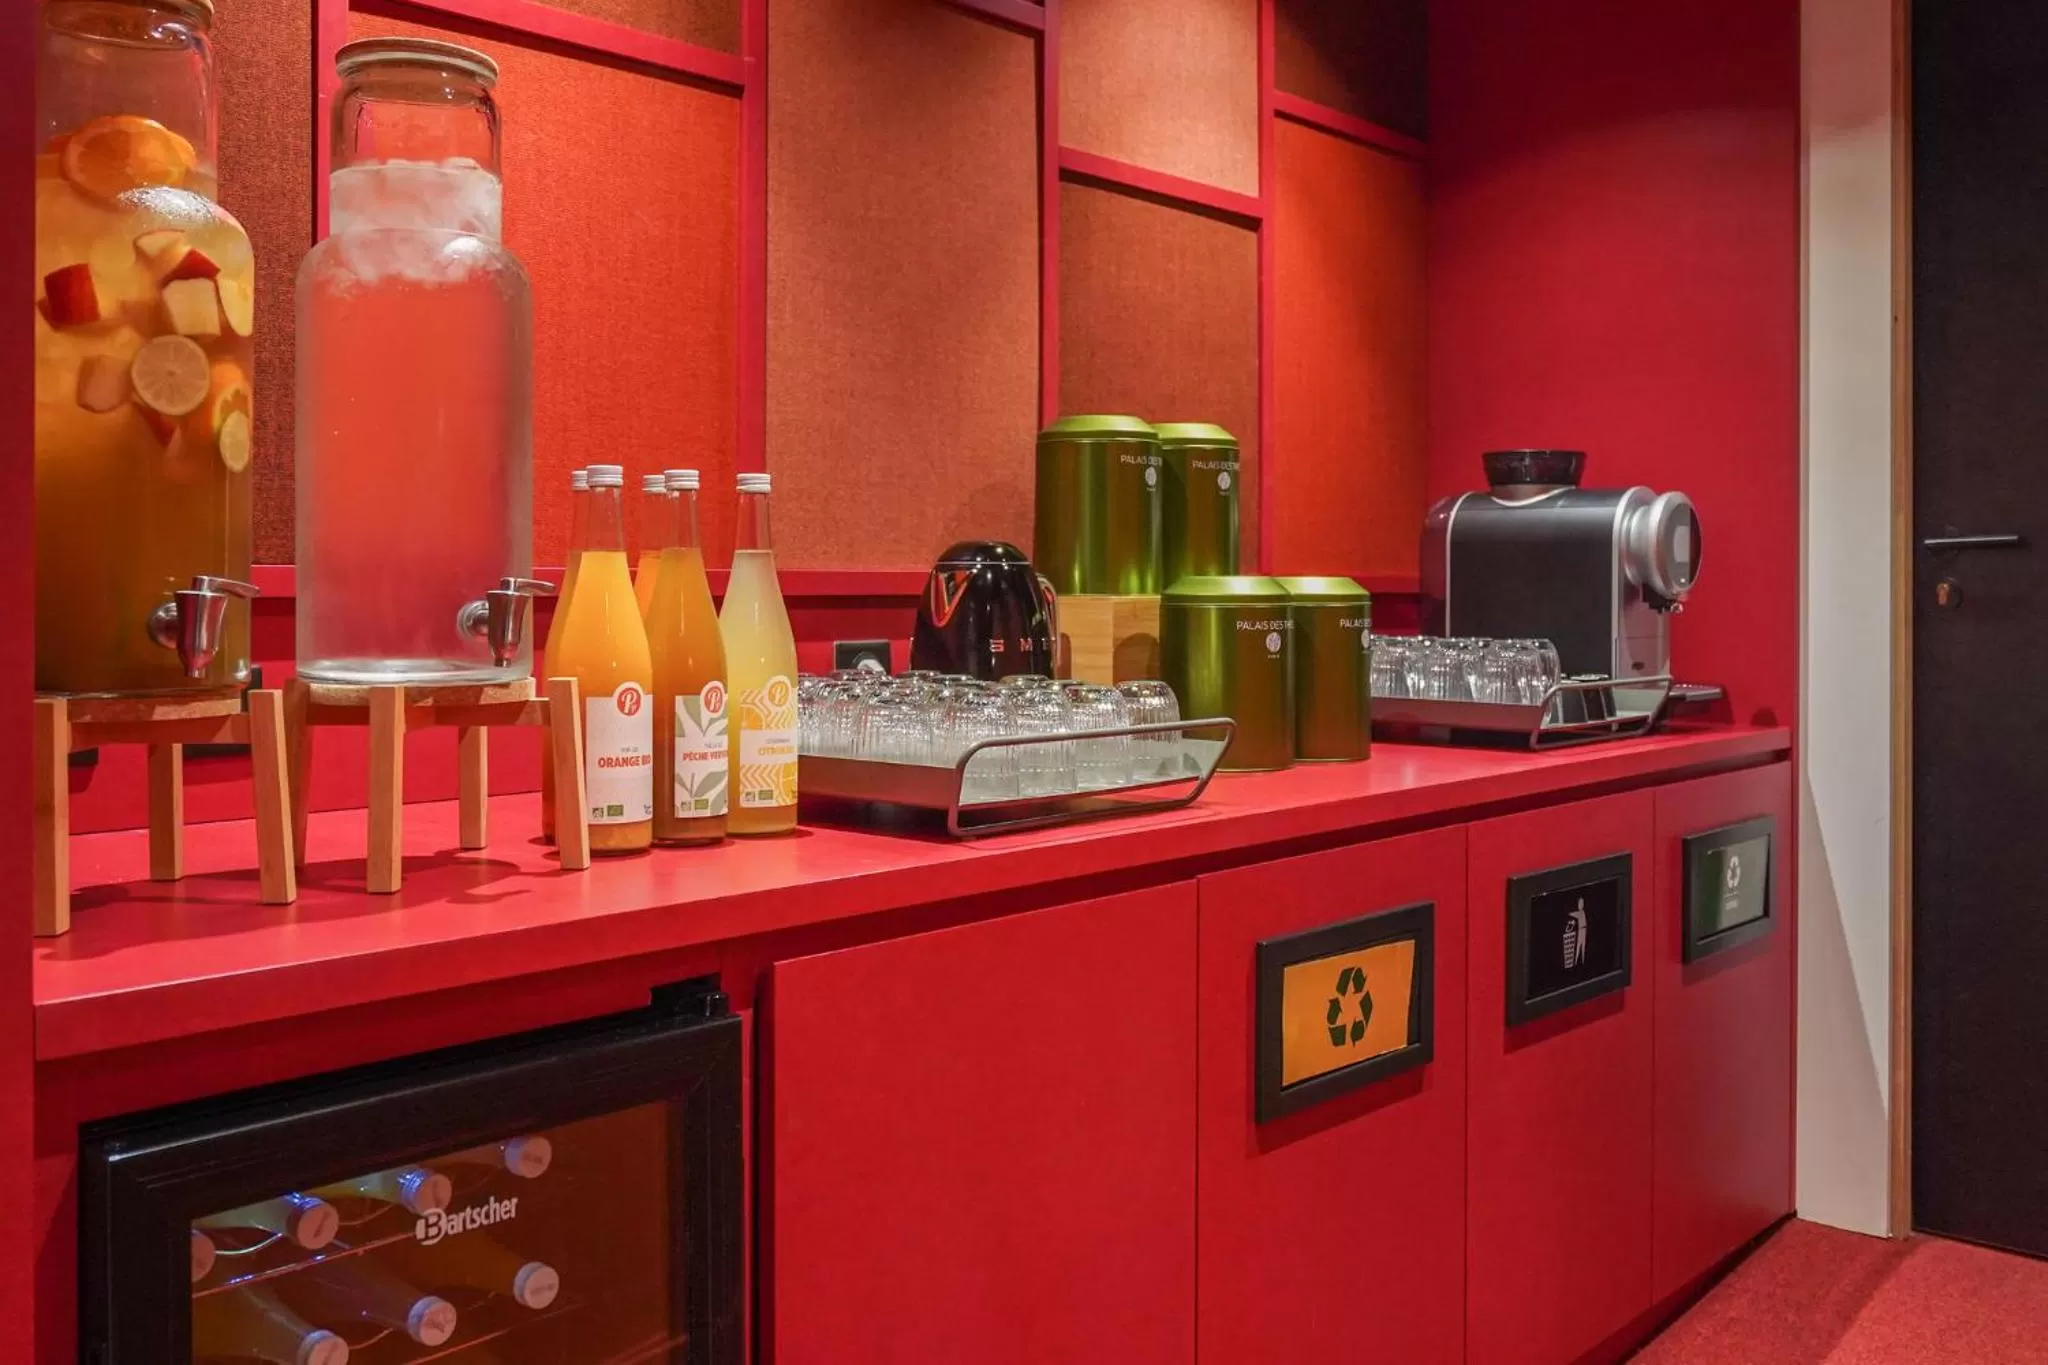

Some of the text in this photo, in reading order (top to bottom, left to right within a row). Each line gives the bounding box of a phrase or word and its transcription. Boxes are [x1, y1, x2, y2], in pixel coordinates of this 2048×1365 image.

[1120, 455, 1147, 465] PALAIS
[1236, 620, 1269, 631] PALAIS
[598, 755, 641, 769] ORANGE
[415, 1196, 518, 1245] Bartscher
